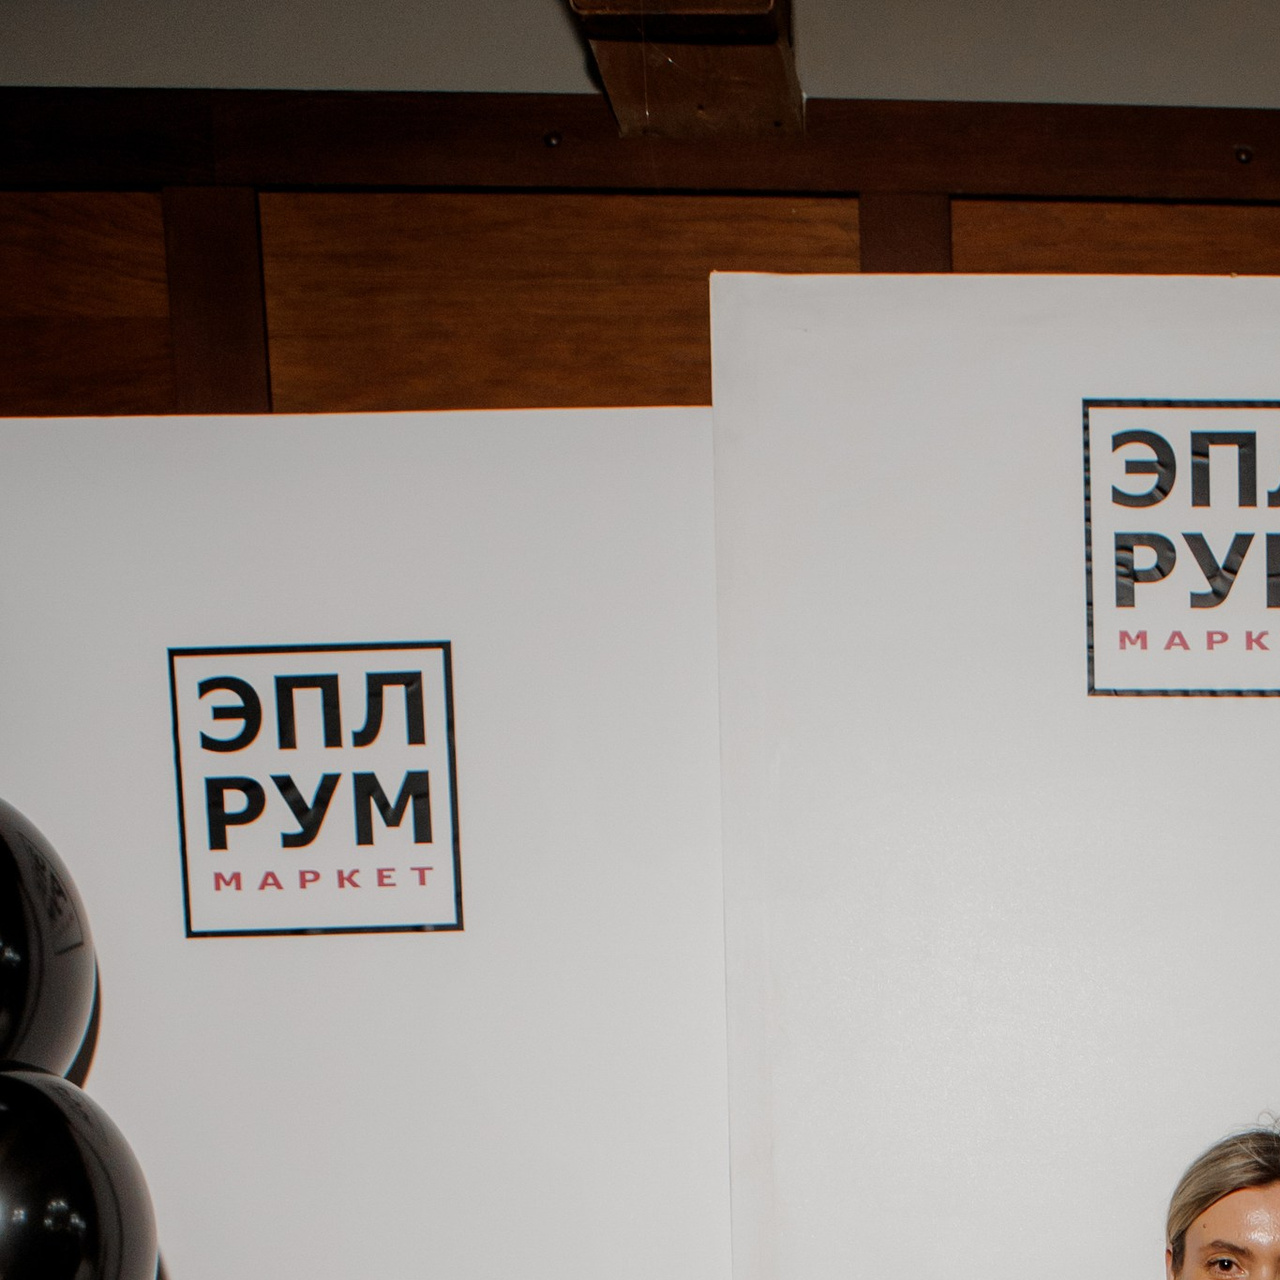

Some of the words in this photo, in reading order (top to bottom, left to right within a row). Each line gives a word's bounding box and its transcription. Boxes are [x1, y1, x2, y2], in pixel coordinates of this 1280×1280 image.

[197, 670, 426, 754] ЭПЛ
[204, 770, 433, 851] РУМ
[213, 867, 434, 891] МАРКЕТ
